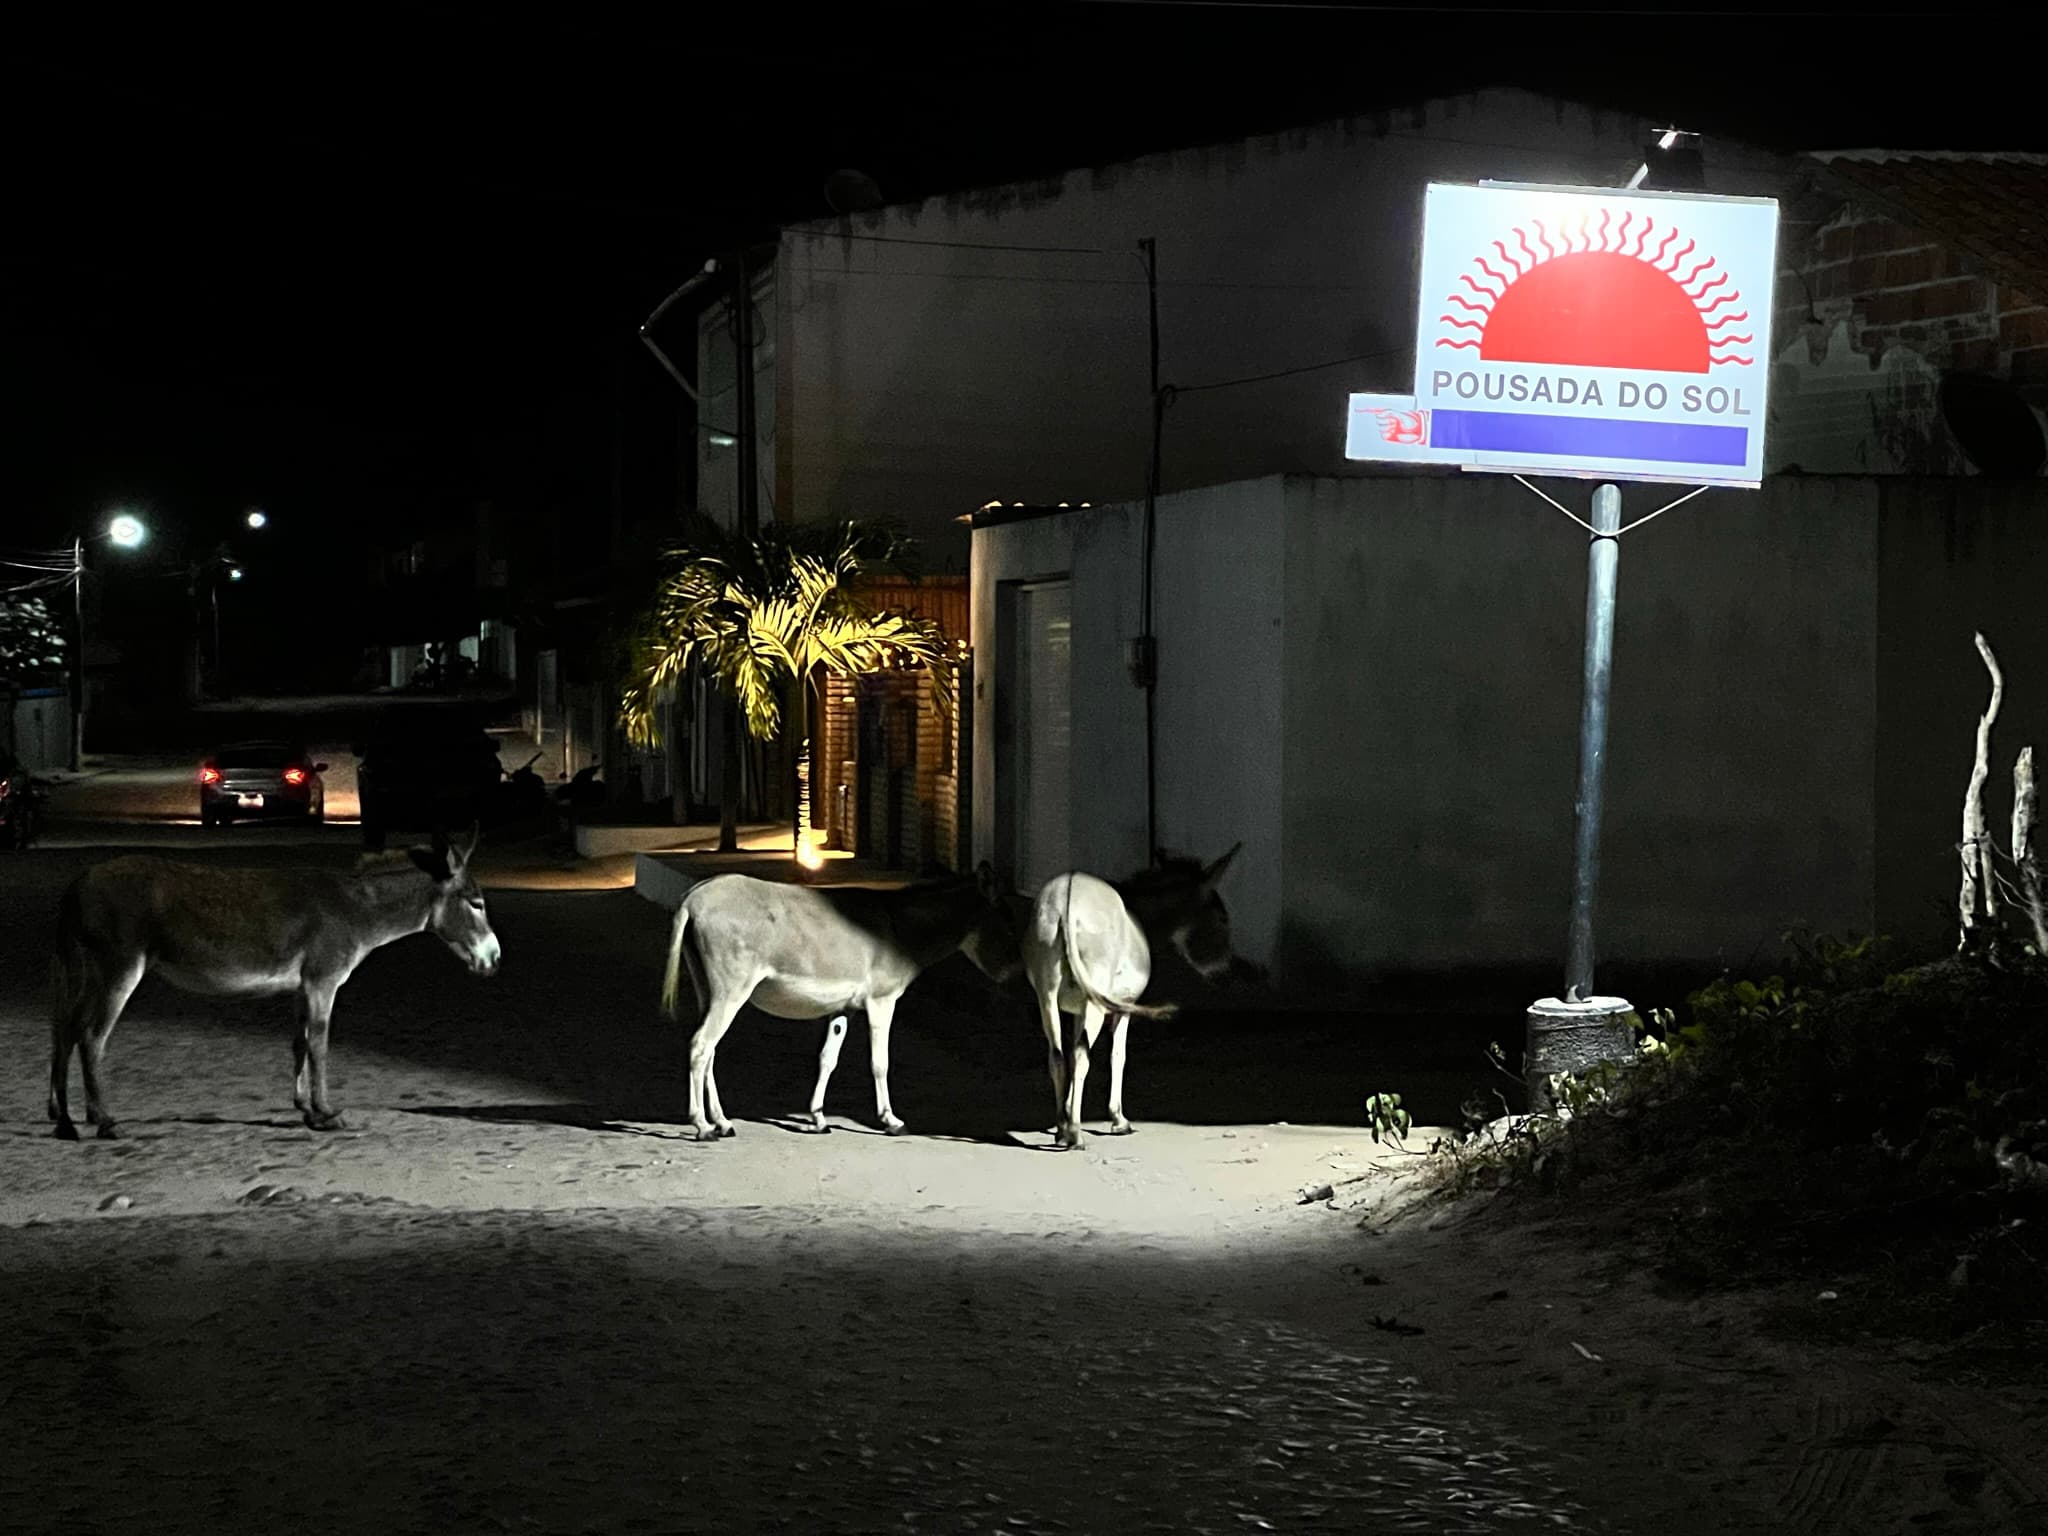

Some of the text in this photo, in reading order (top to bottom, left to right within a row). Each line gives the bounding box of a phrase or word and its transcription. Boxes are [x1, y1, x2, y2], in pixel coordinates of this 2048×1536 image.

[1432, 370, 1751, 415] POUSADA DO SOL
